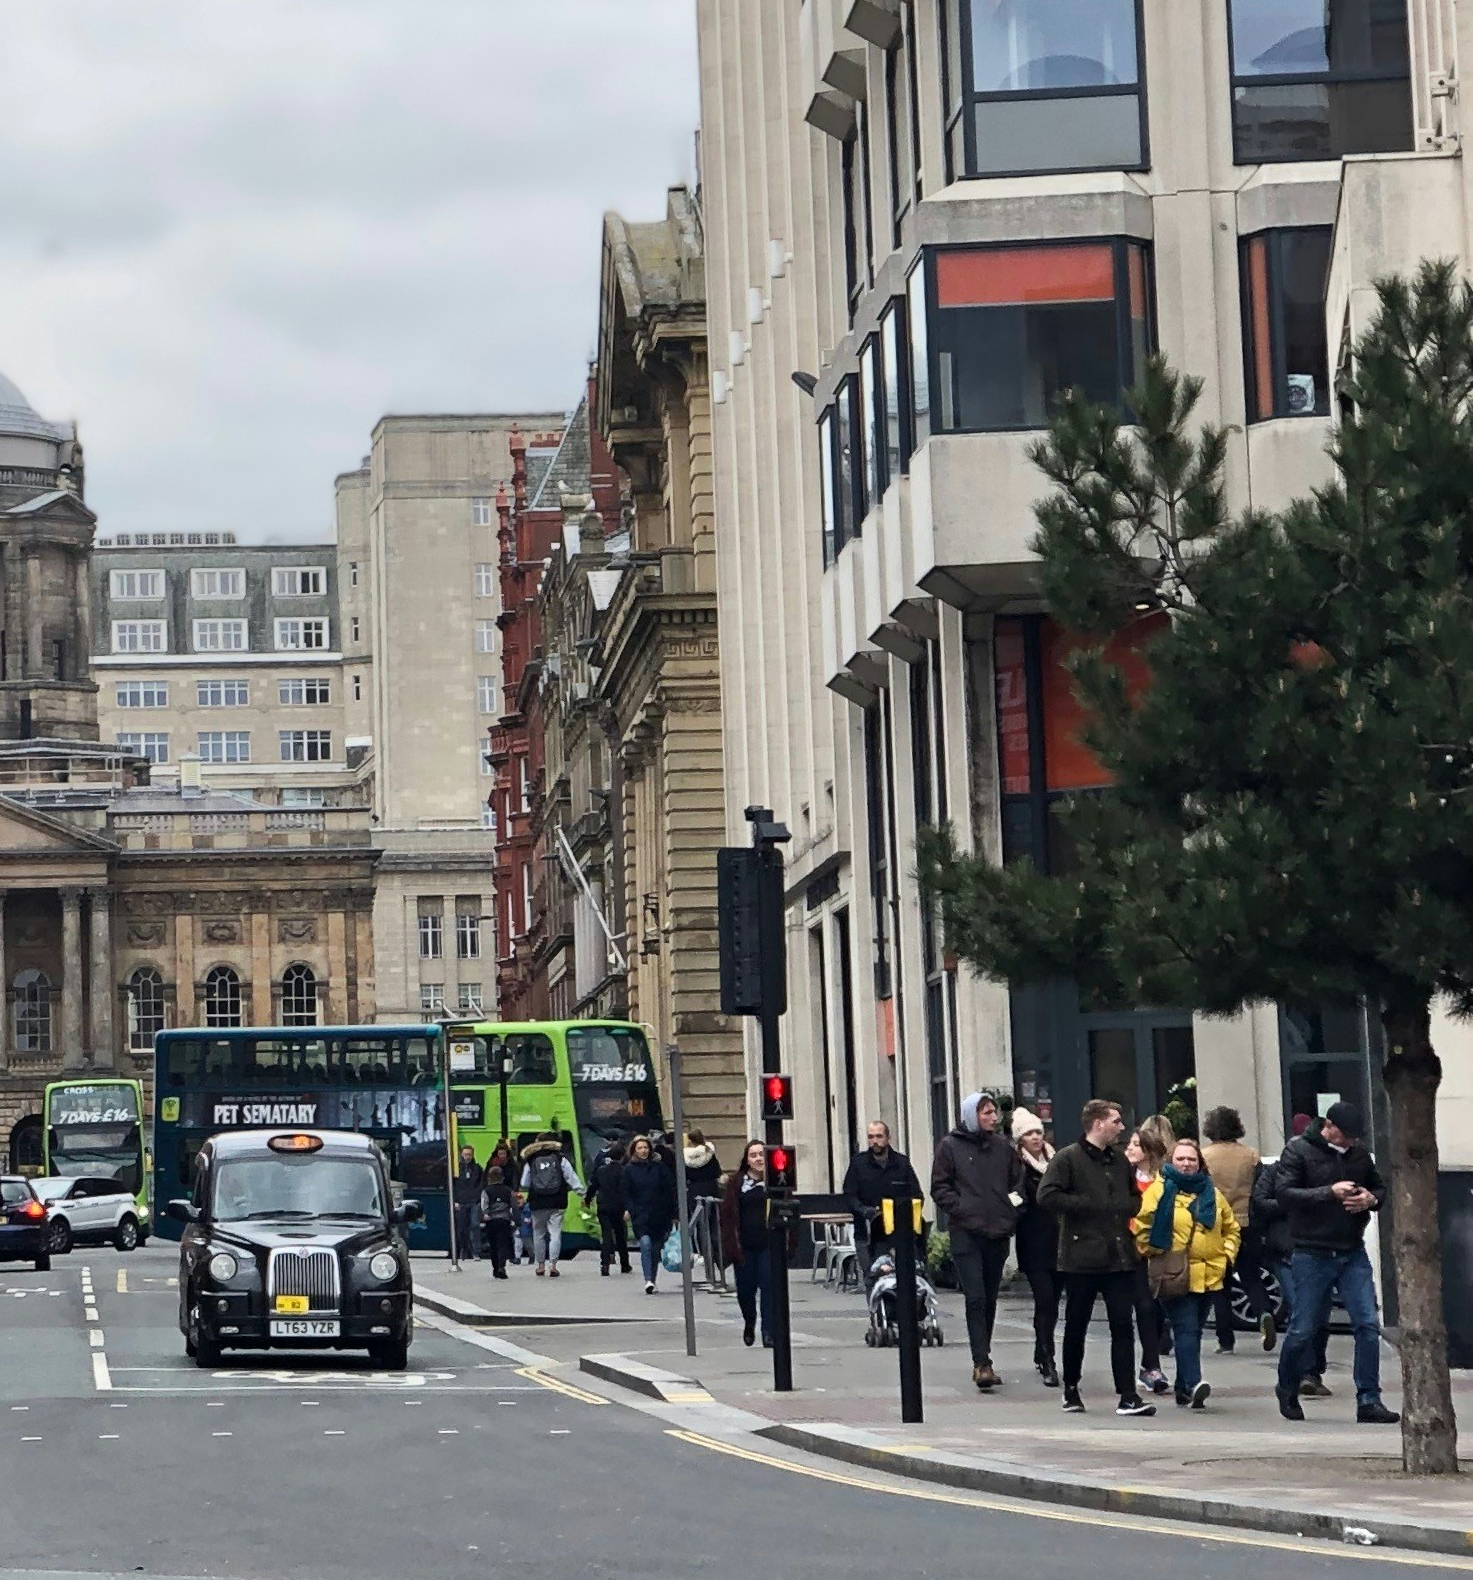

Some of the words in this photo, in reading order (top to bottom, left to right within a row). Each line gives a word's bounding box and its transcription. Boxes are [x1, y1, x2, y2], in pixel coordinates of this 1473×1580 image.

[582, 1066, 591, 1081] 7
[591, 1066, 624, 1081] DAYS
[624, 1063, 647, 1082] £16
[59, 1111, 68, 1124] 7
[67, 1110, 102, 1124] DAYS
[102, 1107, 129, 1122] £16
[213, 1104, 239, 1124] PET
[242, 1104, 317, 1124] SEMATARY
[276, 1322, 308, 1334] LT63
[311, 1322, 335, 1334] YZR
